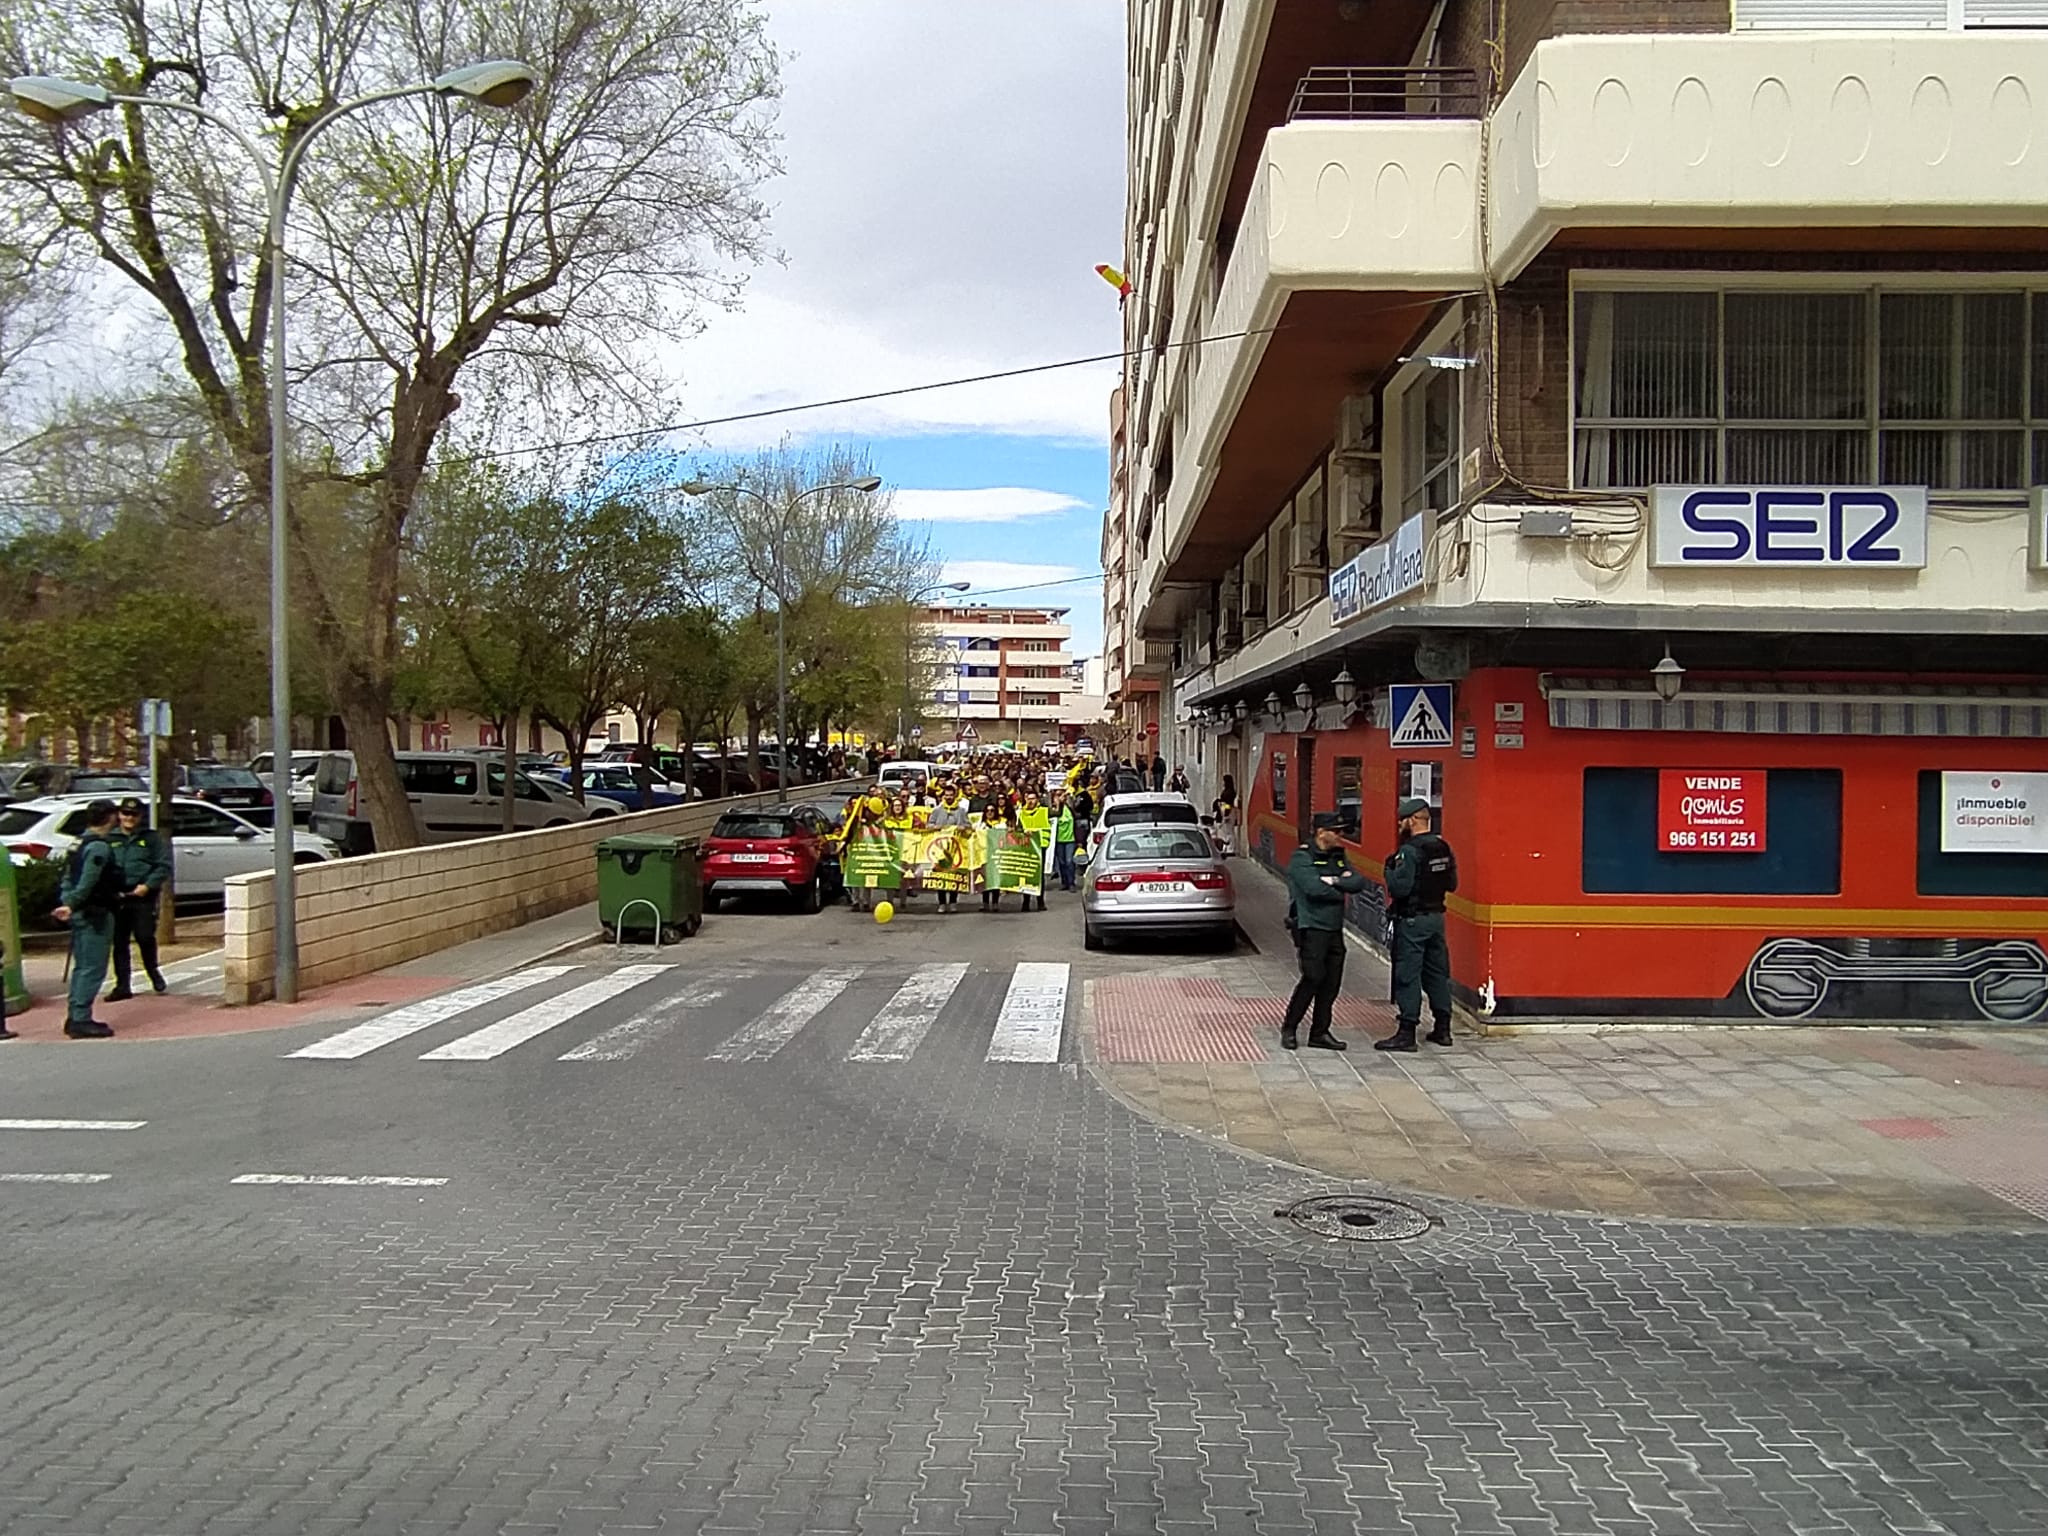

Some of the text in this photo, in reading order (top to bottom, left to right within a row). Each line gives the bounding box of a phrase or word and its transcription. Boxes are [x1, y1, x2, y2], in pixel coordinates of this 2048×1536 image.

[1682, 492, 1900, 561] SER
[1333, 563, 1358, 621] SER
[1360, 562, 1391, 610] Radio
[1685, 777, 1742, 790] VENDE
[1957, 797, 2027, 810] ¡Inmueble
[1957, 814, 2035, 828] disponible!
[1669, 832, 1756, 846] 966 151 251
